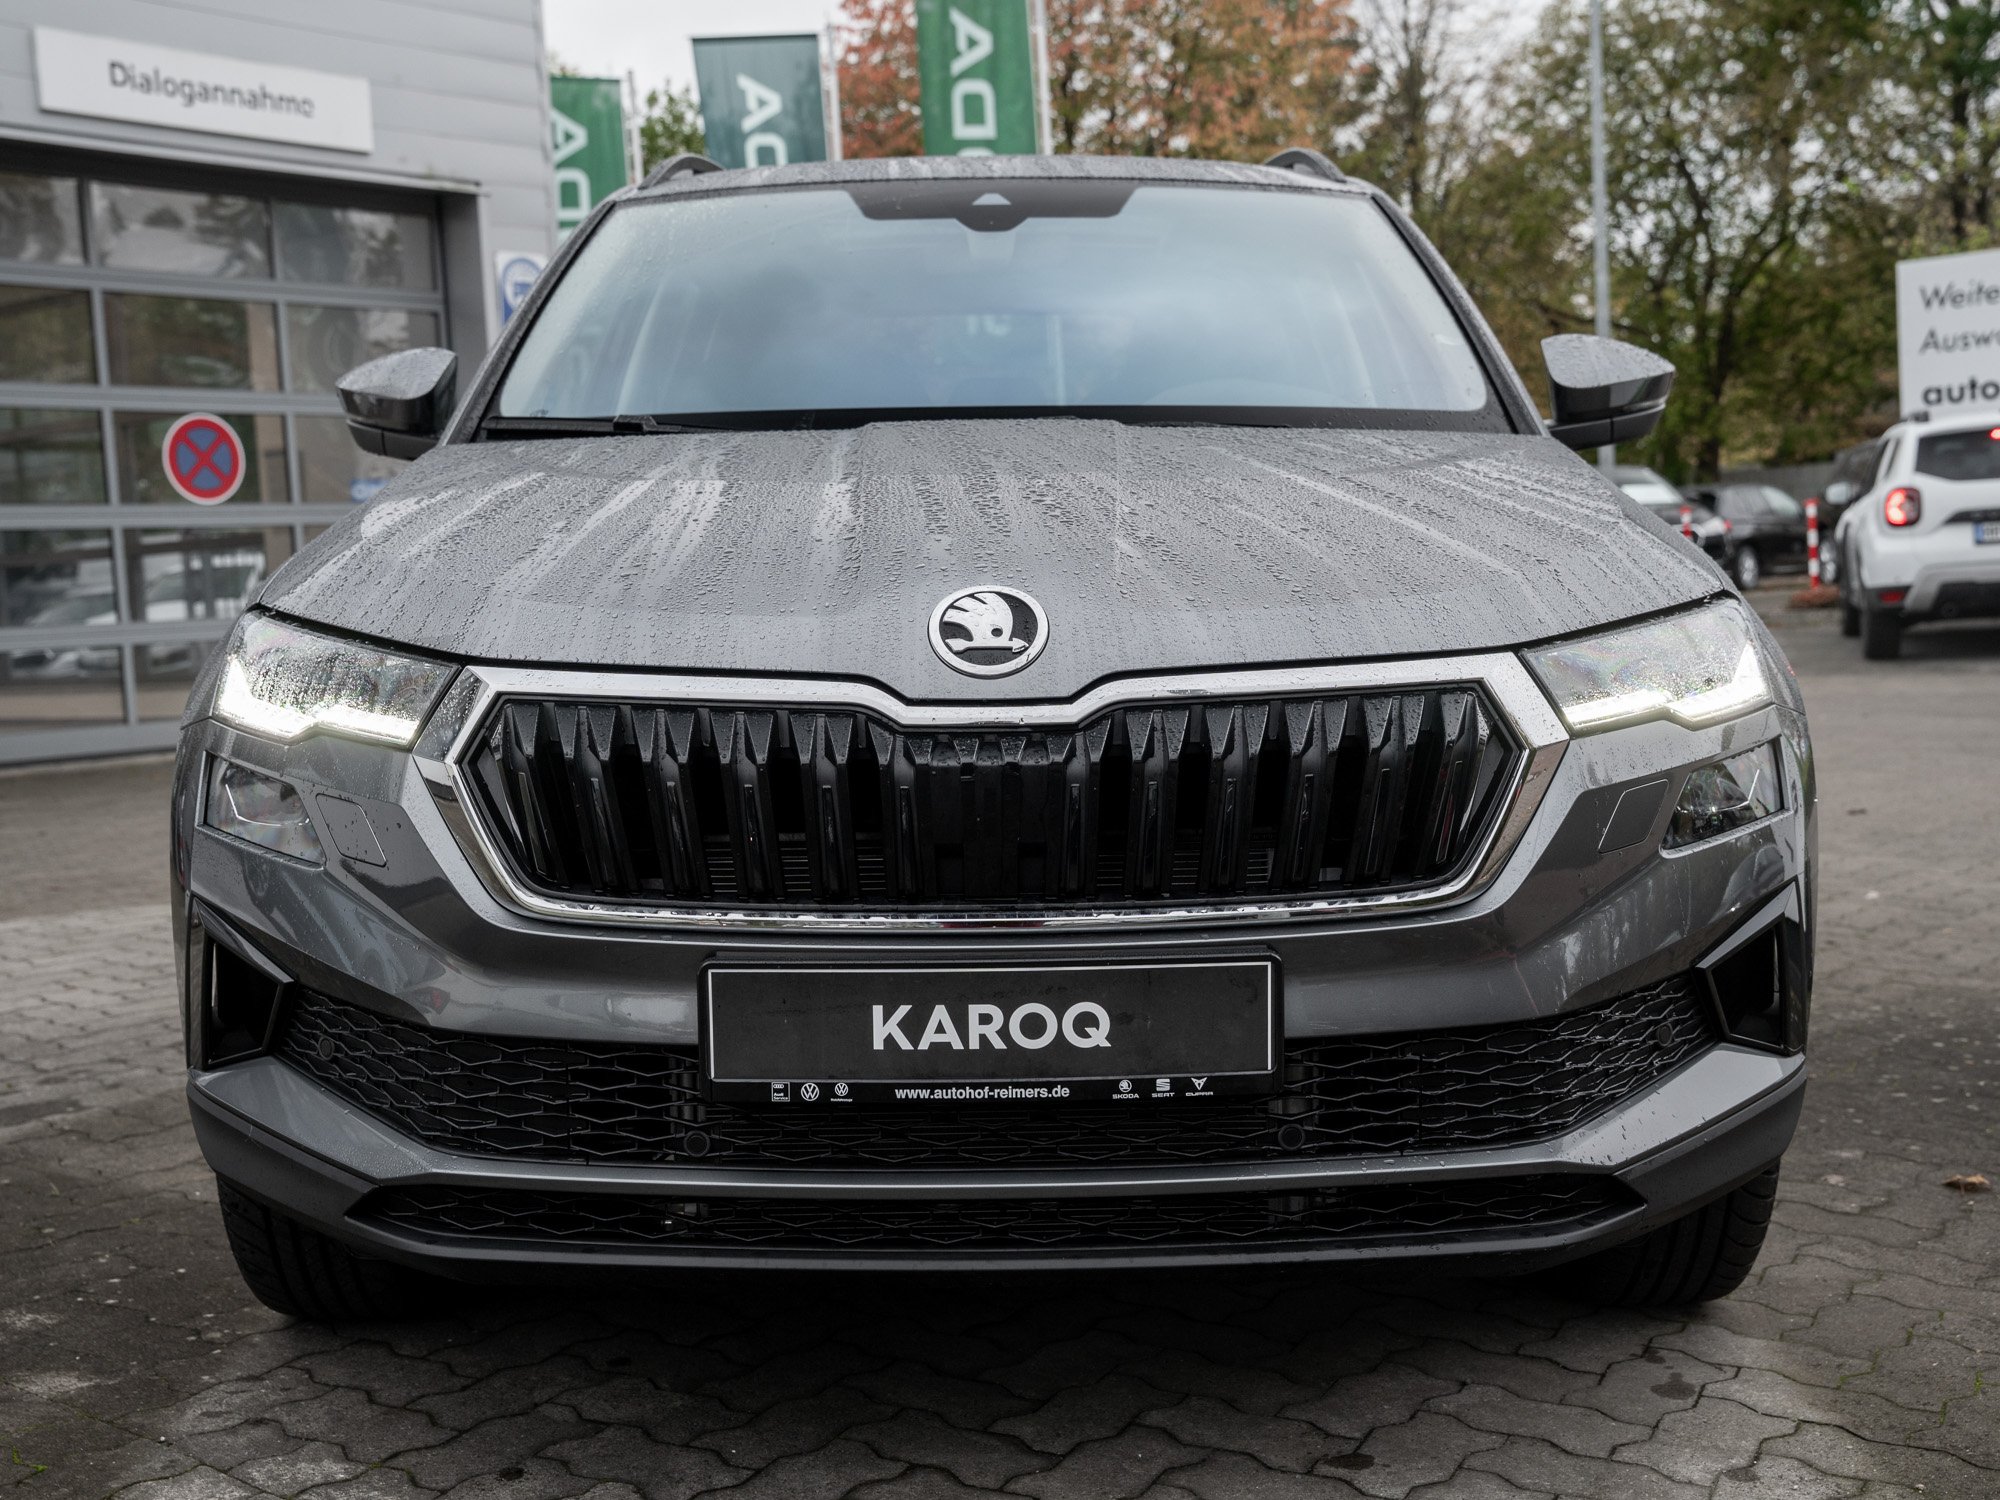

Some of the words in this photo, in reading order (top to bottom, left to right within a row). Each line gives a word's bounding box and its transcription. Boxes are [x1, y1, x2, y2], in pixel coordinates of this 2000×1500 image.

[108, 60, 316, 119] Dialogannahme
[1922, 376, 2000, 406] auto
[872, 1001, 1112, 1051] KAROQ
[894, 1084, 1071, 1099] www.autohof-reimers.de
